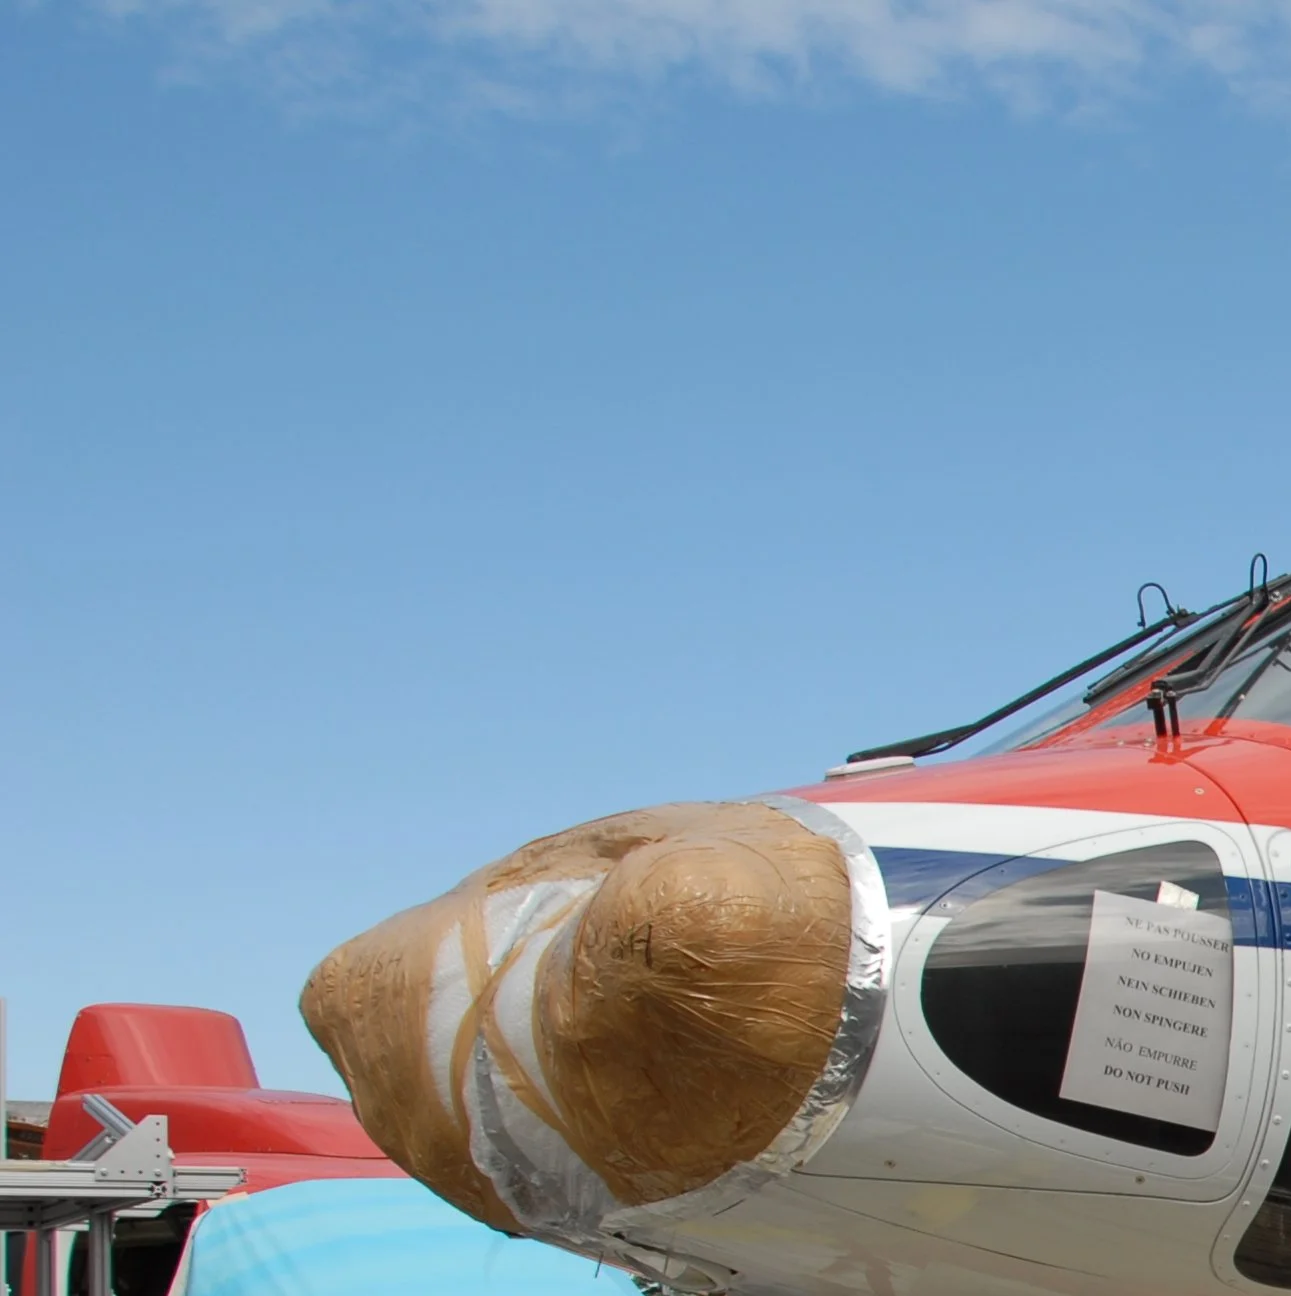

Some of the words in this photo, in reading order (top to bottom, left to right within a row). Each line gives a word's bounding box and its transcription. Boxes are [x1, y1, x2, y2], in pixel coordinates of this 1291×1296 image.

[1125, 916, 1142, 929] NE
[1146, 920, 1170, 936] PAS
[1172, 928, 1230, 953] POUSSER
[1131, 948, 1151, 962] NO
[1154, 954, 1214, 978] EMPUJEN
[1117, 975, 1150, 992] NEIN
[1151, 981, 1217, 1009] SCHIEBEN
[1112, 1004, 1142, 1021] NON
[1143, 1012, 1209, 1038] SPINGERE
[1138, 1046, 1198, 1071] EMPURRE
[1103, 1064, 1123, 1079] DO
[1125, 1070, 1154, 1086] NOT
[1156, 1078, 1191, 1096] PUSH
